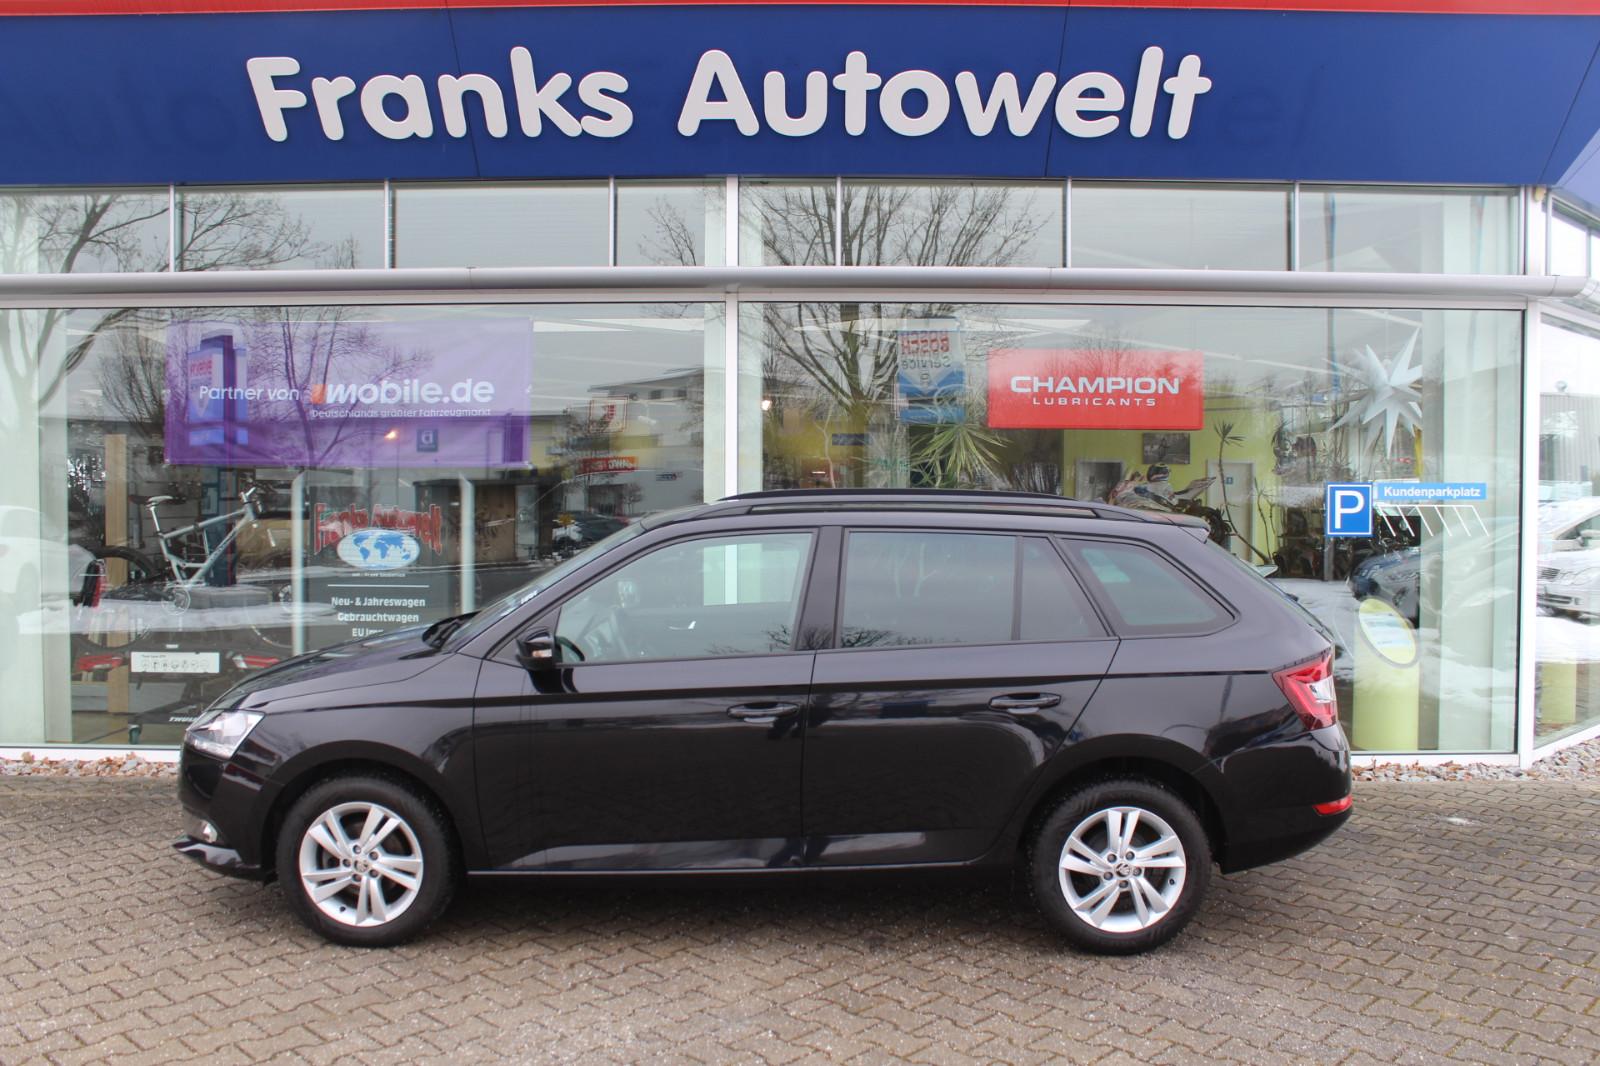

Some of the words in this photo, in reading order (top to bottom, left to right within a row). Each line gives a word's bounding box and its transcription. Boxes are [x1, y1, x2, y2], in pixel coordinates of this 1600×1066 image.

[246, 46, 634, 142] Franks
[677, 46, 1212, 140] Autowelt
[326, 378, 495, 404] mobile.de
[1010, 376, 1179, 394] CHAMPION
[200, 385, 262, 400] Partner
[268, 388, 299, 400] von
[1033, 397, 1156, 407] LUBRICANTS
[312, 409, 379, 418] Deutschlands
[419, 408, 490, 418] Fahrzeugmarkt
[1384, 486, 1480, 499] Kundenparkplatz
[1334, 490, 1364, 529] P
[331, 597, 354, 606] Neu-
[355, 597, 361, 606] &
[362, 597, 426, 608] Jahreswagen
[337, 612, 419, 623] Gebrauchtwagen
[352, 628, 364, 637] EU
